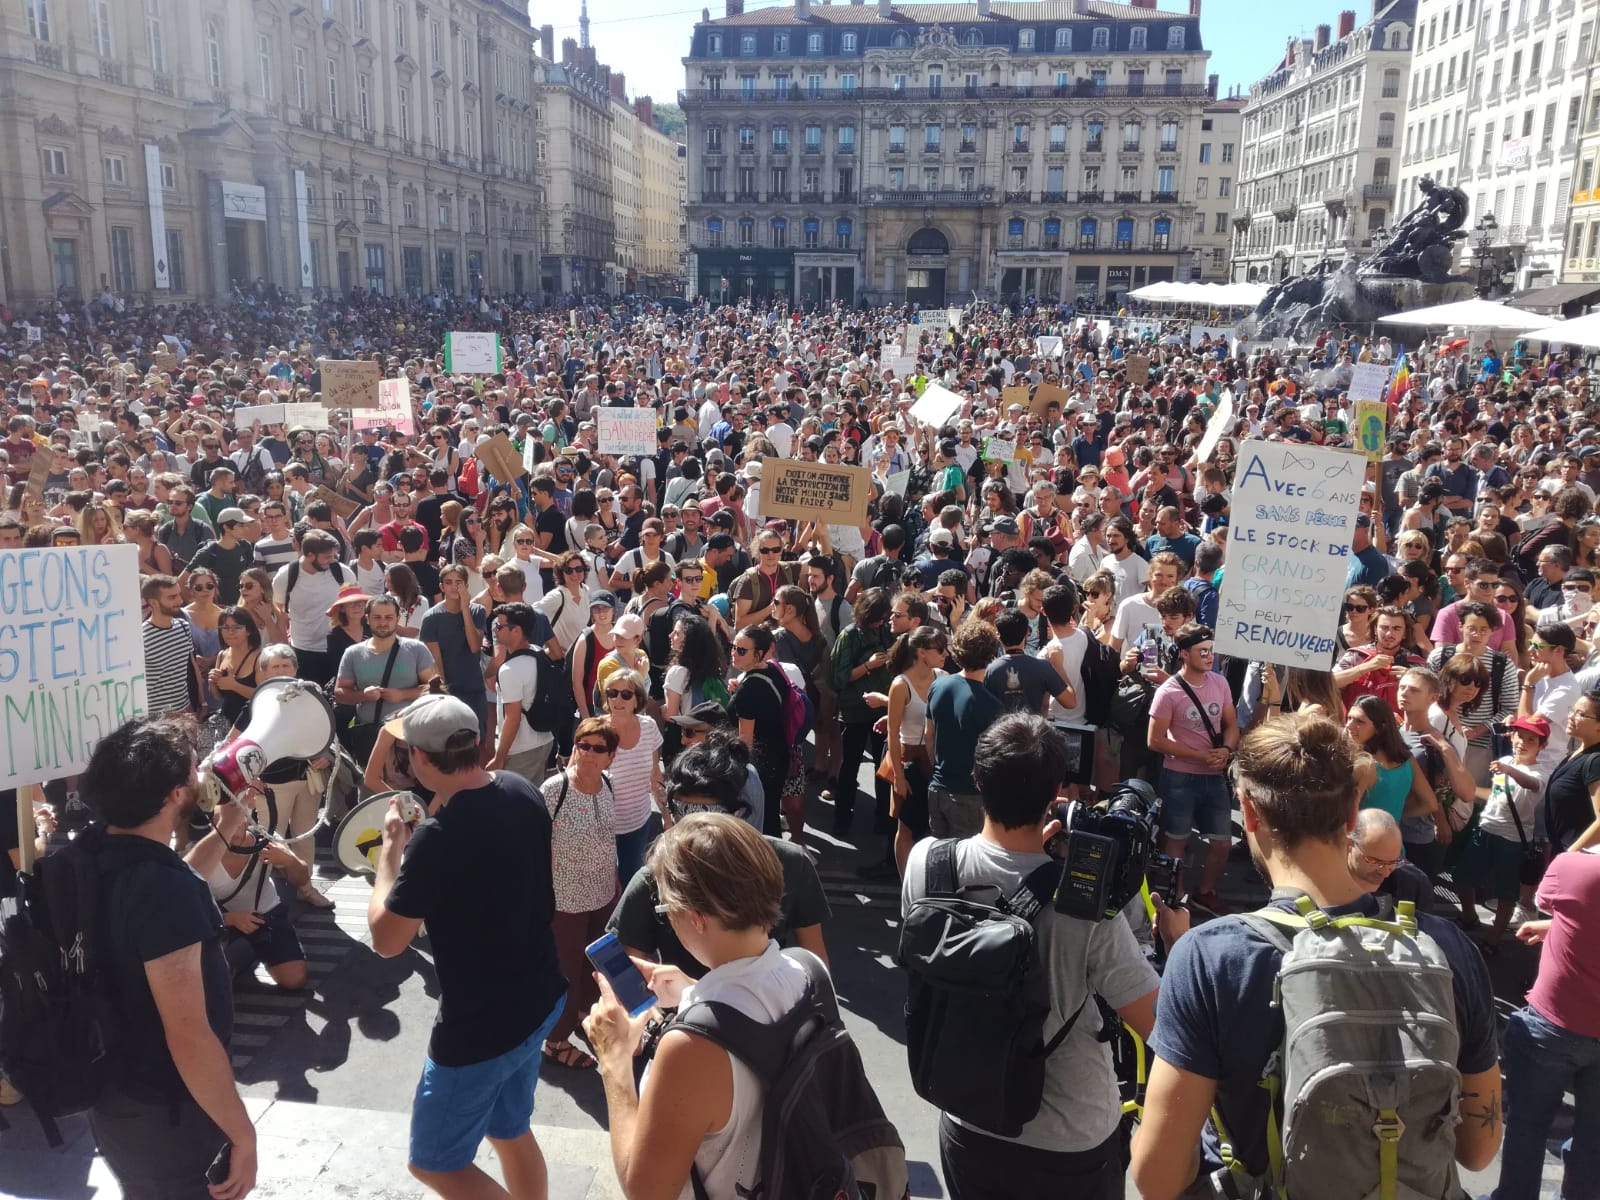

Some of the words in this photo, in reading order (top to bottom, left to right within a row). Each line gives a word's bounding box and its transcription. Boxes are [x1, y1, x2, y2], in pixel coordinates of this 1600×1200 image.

[777, 477, 787, 486] LA
[790, 480, 838, 492] DESTRUCTION
[786, 469, 806, 478] DOIT
[807, 471, 816, 480] ON
[818, 472, 850, 484] ATTENDRE
[776, 486, 800, 496] NOTRE
[802, 489, 828, 498] MONDE
[830, 491, 850, 502] SANS
[776, 494, 794, 504] RIEN
[800, 498, 825, 508] FAIRE
[1312, 479, 1328, 500] 6
[1328, 492, 1357, 504] ANS
[1256, 504, 1300, 523] SANS
[1305, 508, 1348, 528] PÊCHE
[1234, 526, 1256, 542] LE
[1266, 532, 1320, 553] STOCK
[1328, 544, 1350, 556] DE
[1242, 553, 1328, 584] GRANDS
[0, 549, 112, 614] GEONS
[1242, 578, 1338, 612] POISSONS
[1254, 610, 1292, 625] PEUT
[1218, 614, 1234, 626] SE
[1234, 622, 1334, 654] RENOUVELER
